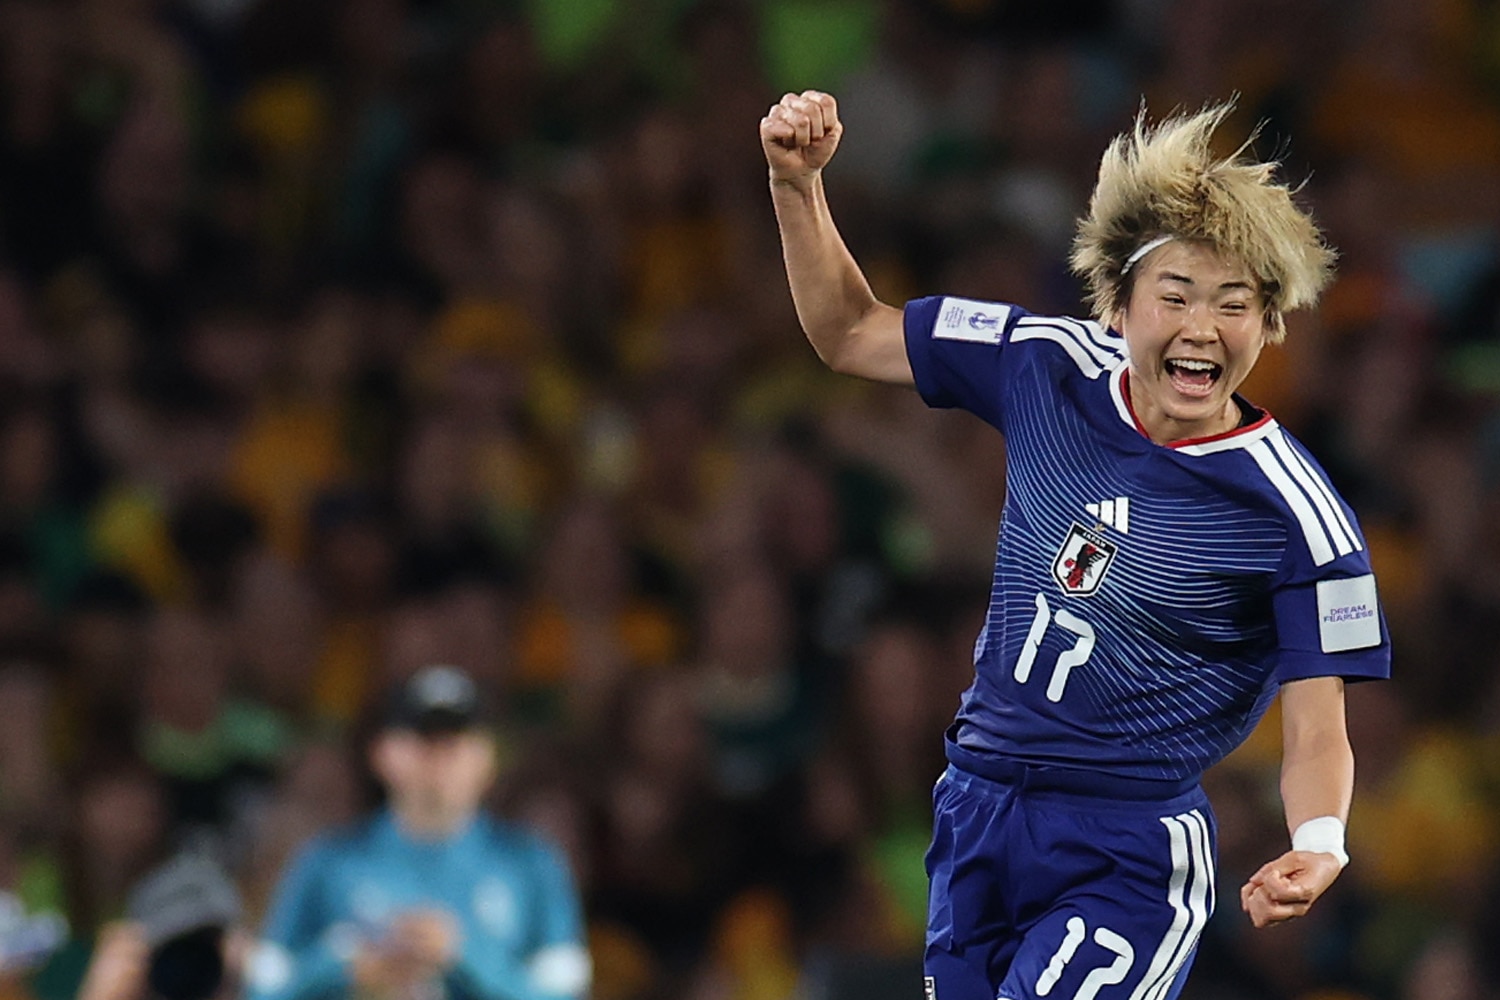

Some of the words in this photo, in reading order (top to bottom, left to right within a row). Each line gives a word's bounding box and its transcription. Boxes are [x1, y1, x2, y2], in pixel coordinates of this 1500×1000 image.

[1323, 609, 1374, 623] FEARLESS
[1330, 604, 1367, 616] DREAM
[1013, 592, 1096, 702] 17
